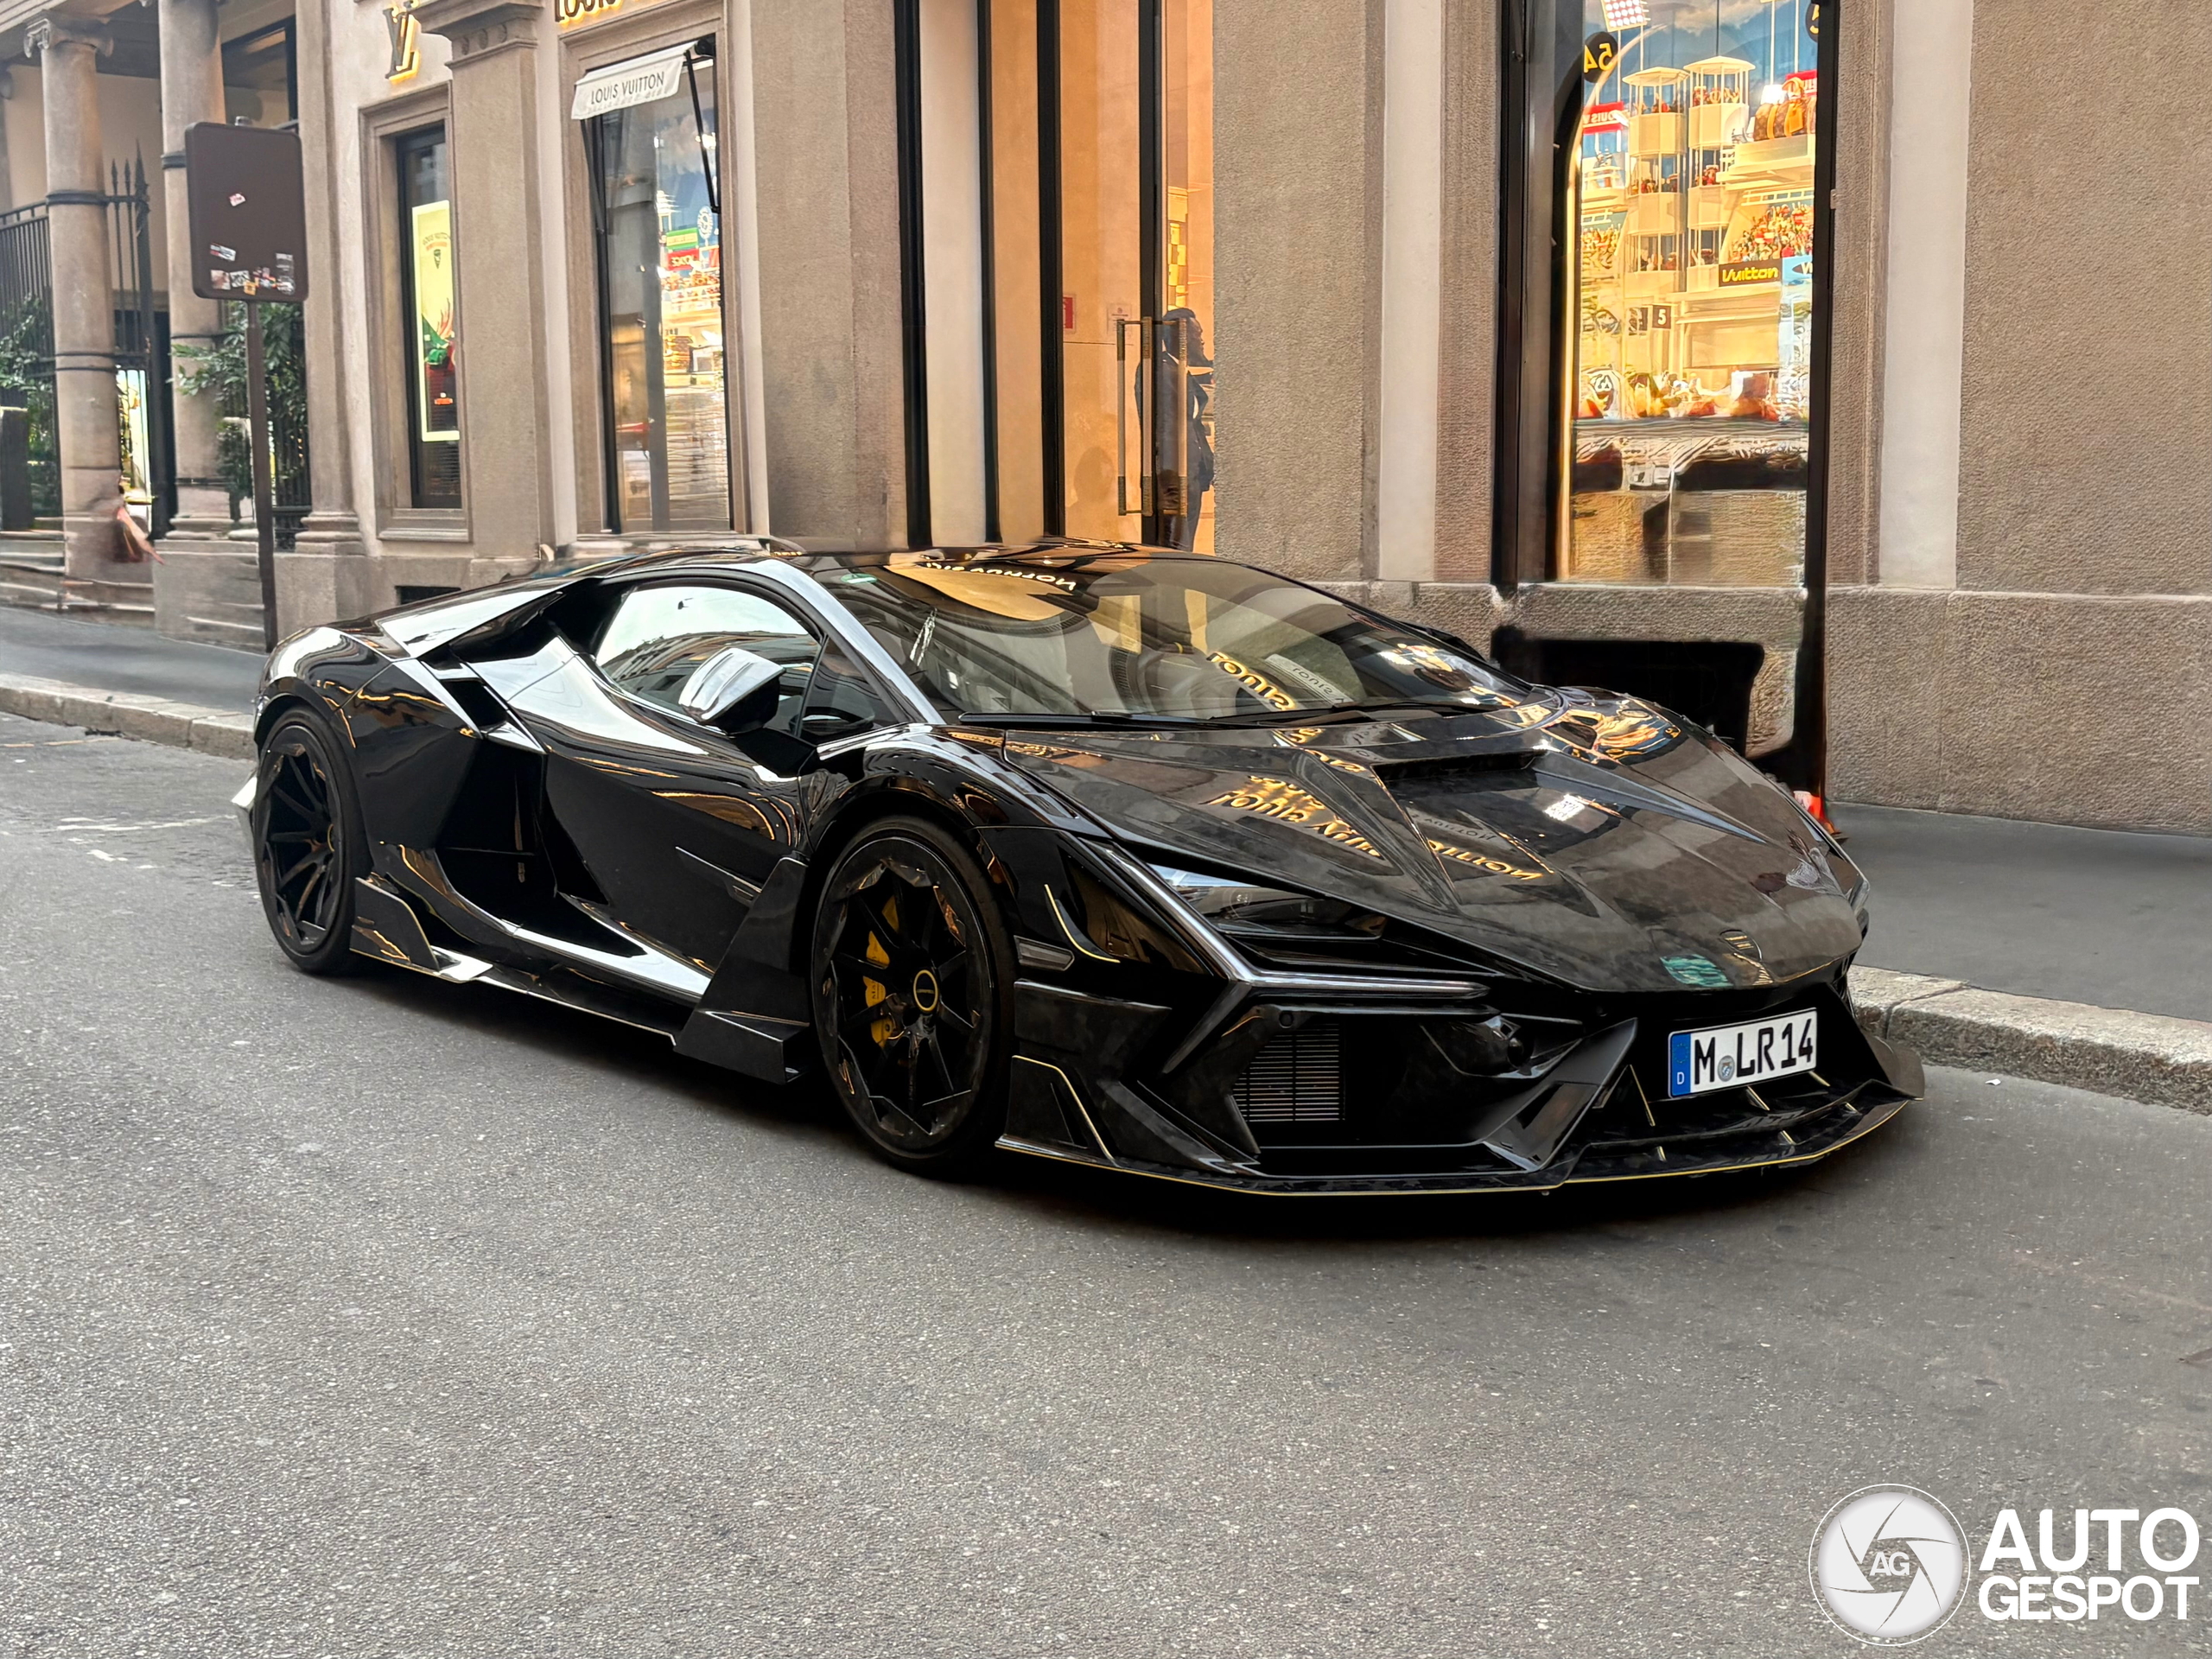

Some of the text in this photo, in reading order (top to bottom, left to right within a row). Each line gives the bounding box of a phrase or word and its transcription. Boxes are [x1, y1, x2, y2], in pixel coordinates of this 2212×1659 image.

[590, 71, 664, 105] LOUIS VUITTON
[1722, 267, 1779, 283] Vuitton
[1657, 308, 1667, 325] 5
[1676, 1071, 1685, 1085] D
[1694, 1037, 1716, 1085] M
